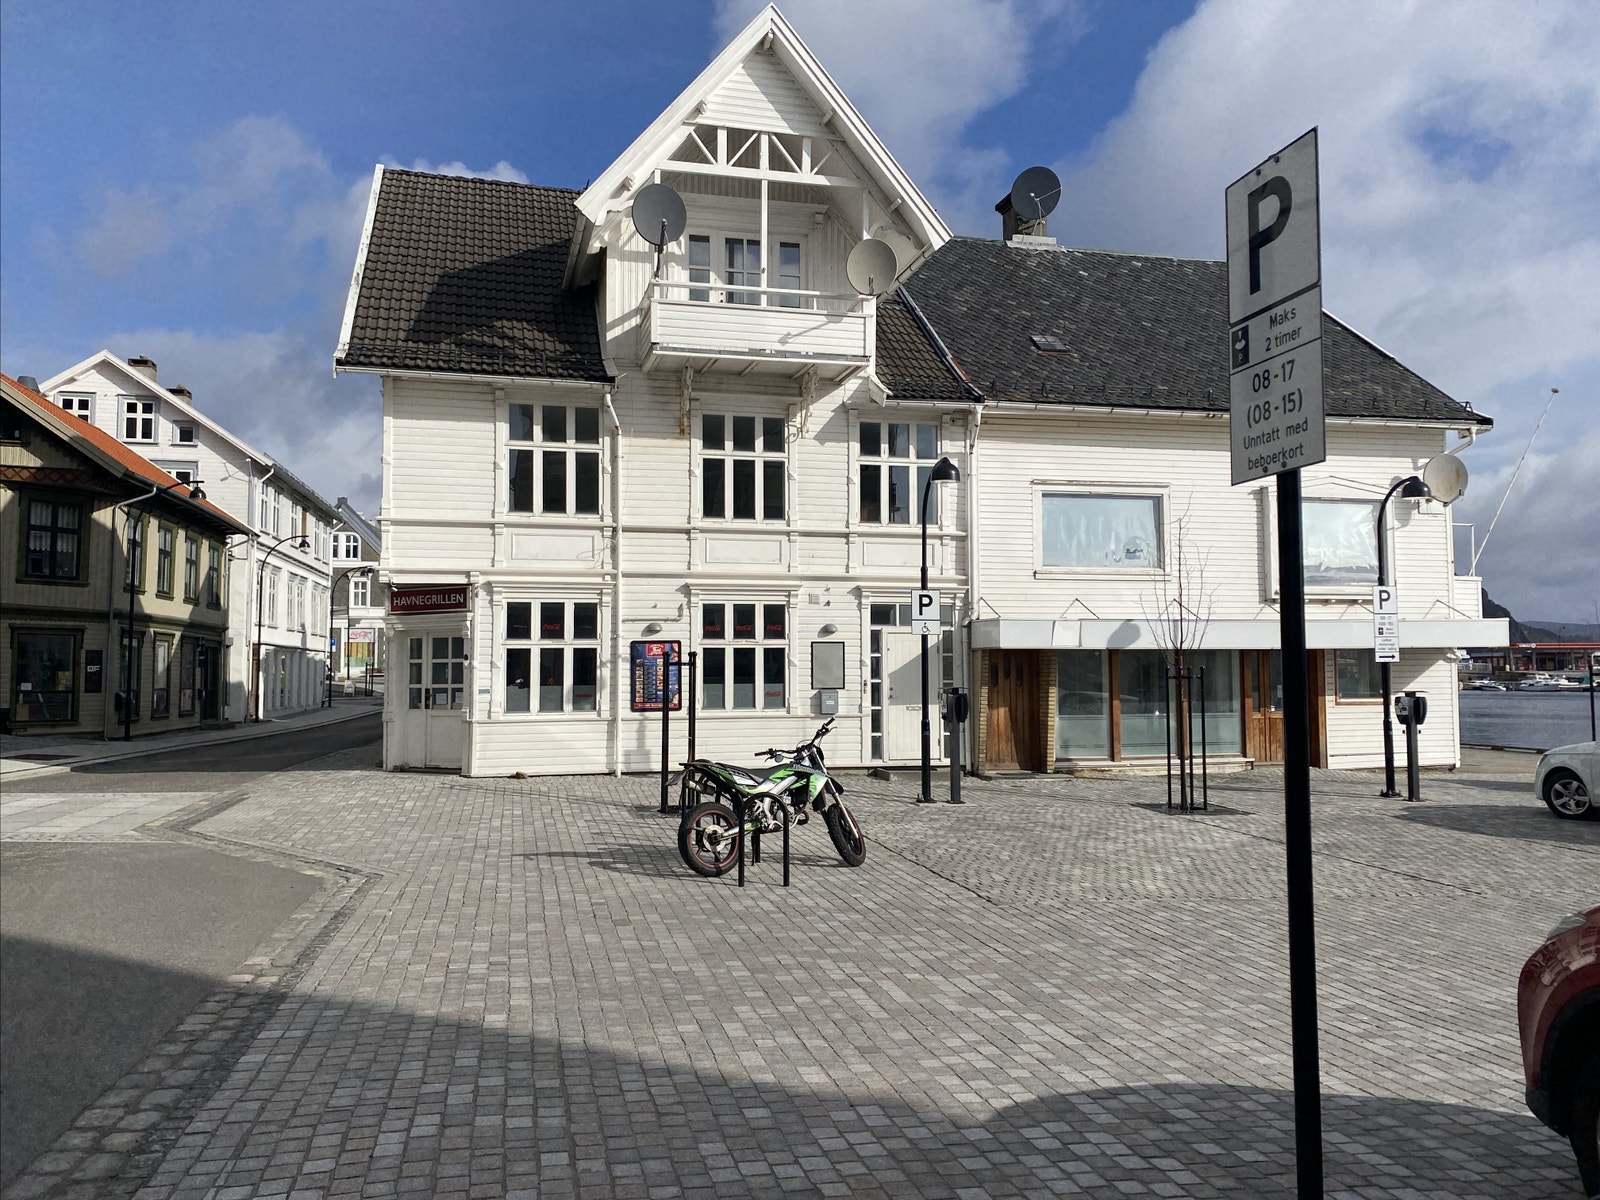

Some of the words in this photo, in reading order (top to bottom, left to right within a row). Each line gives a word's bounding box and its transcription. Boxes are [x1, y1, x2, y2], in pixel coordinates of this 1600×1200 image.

[1248, 175, 1293, 296] P
[1269, 307, 1297, 330] Maks
[1265, 337, 1272, 352] 2
[1274, 326, 1302, 349] timer
[1243, 426, 1281, 450] Unntatt
[1285, 416, 1308, 438] med
[1248, 442, 1304, 470] beboerkort
[393, 593, 464, 607] HAVNEGRILLEN
[918, 593, 933, 616] P
[1379, 589, 1391, 610] P
